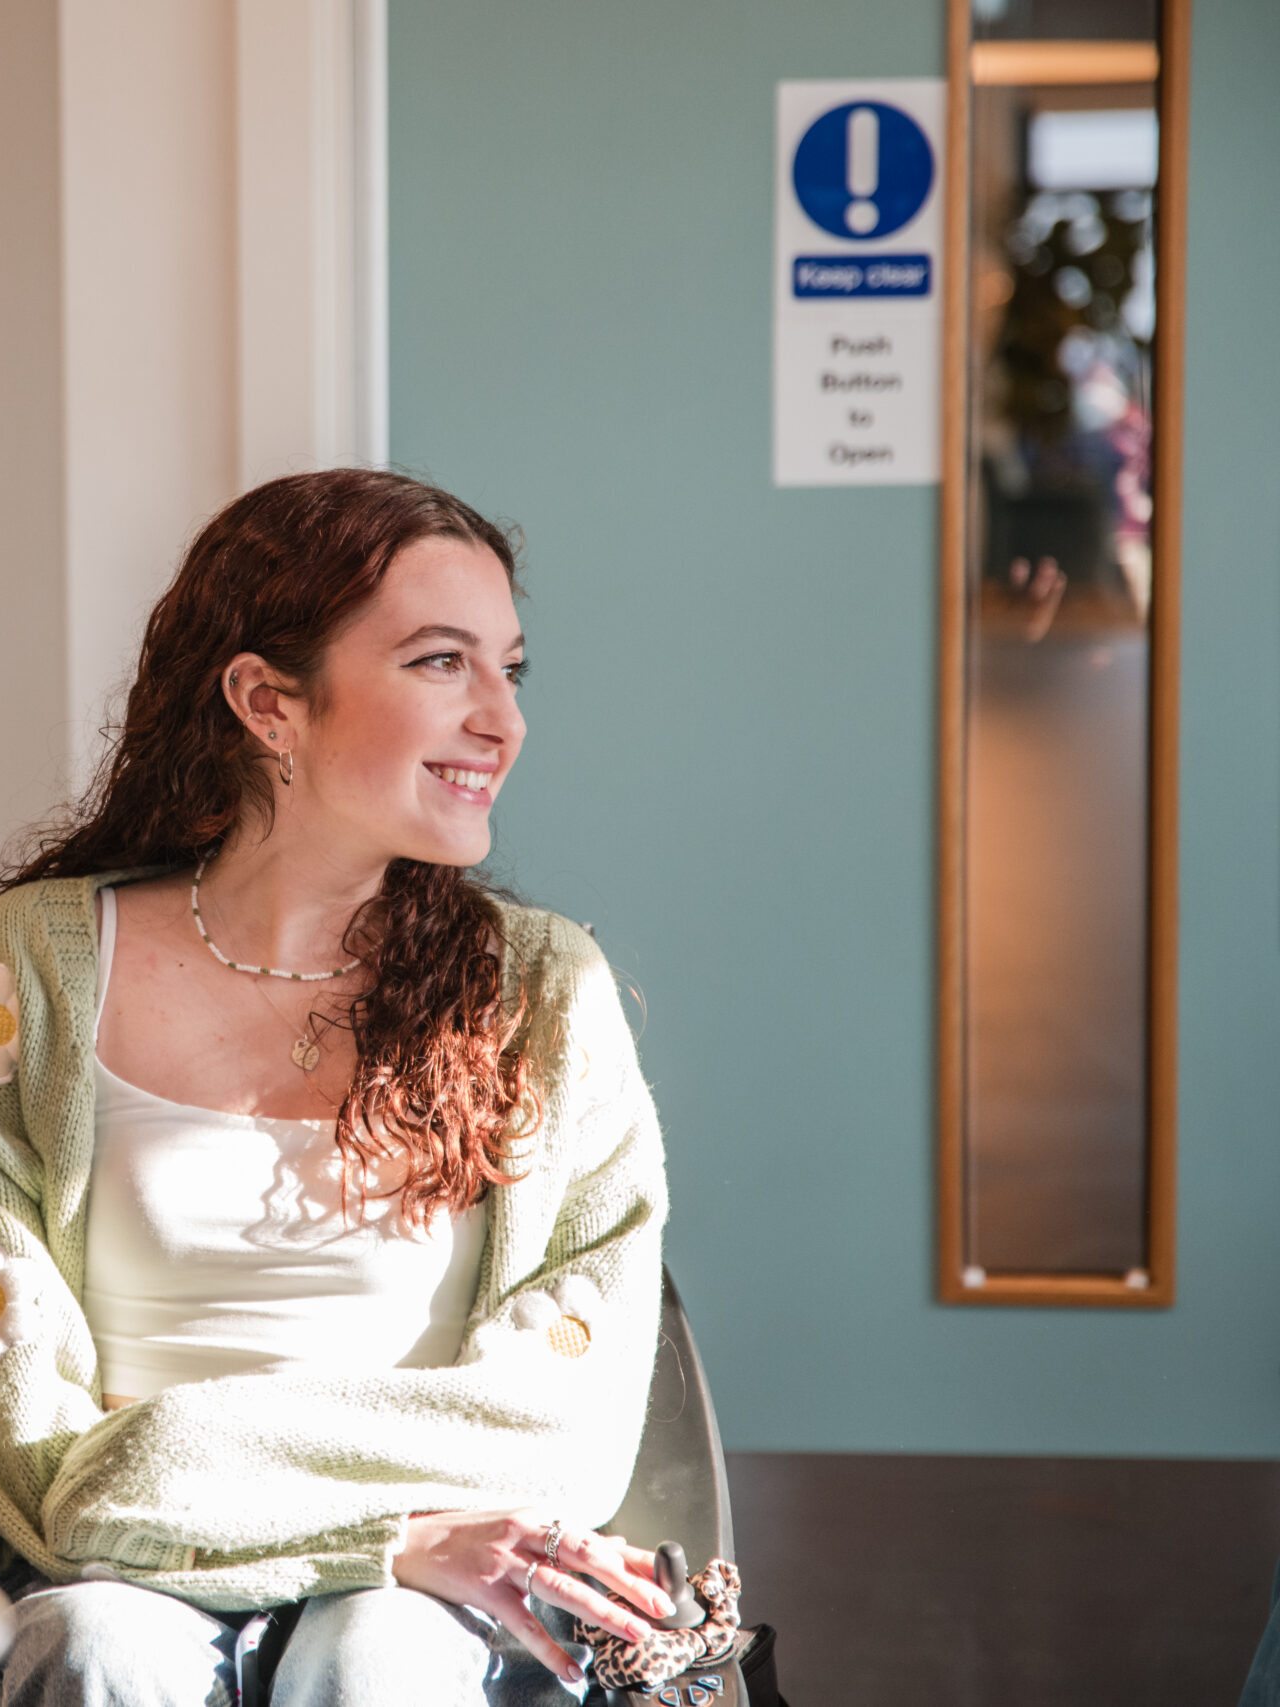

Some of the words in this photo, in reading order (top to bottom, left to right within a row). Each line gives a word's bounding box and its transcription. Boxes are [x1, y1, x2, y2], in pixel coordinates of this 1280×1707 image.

[798, 263, 863, 292] Keep
[867, 261, 927, 289] clear
[831, 336, 892, 356] Push
[821, 371, 902, 392] Button
[848, 408, 873, 428] to
[829, 444, 893, 467] Open
